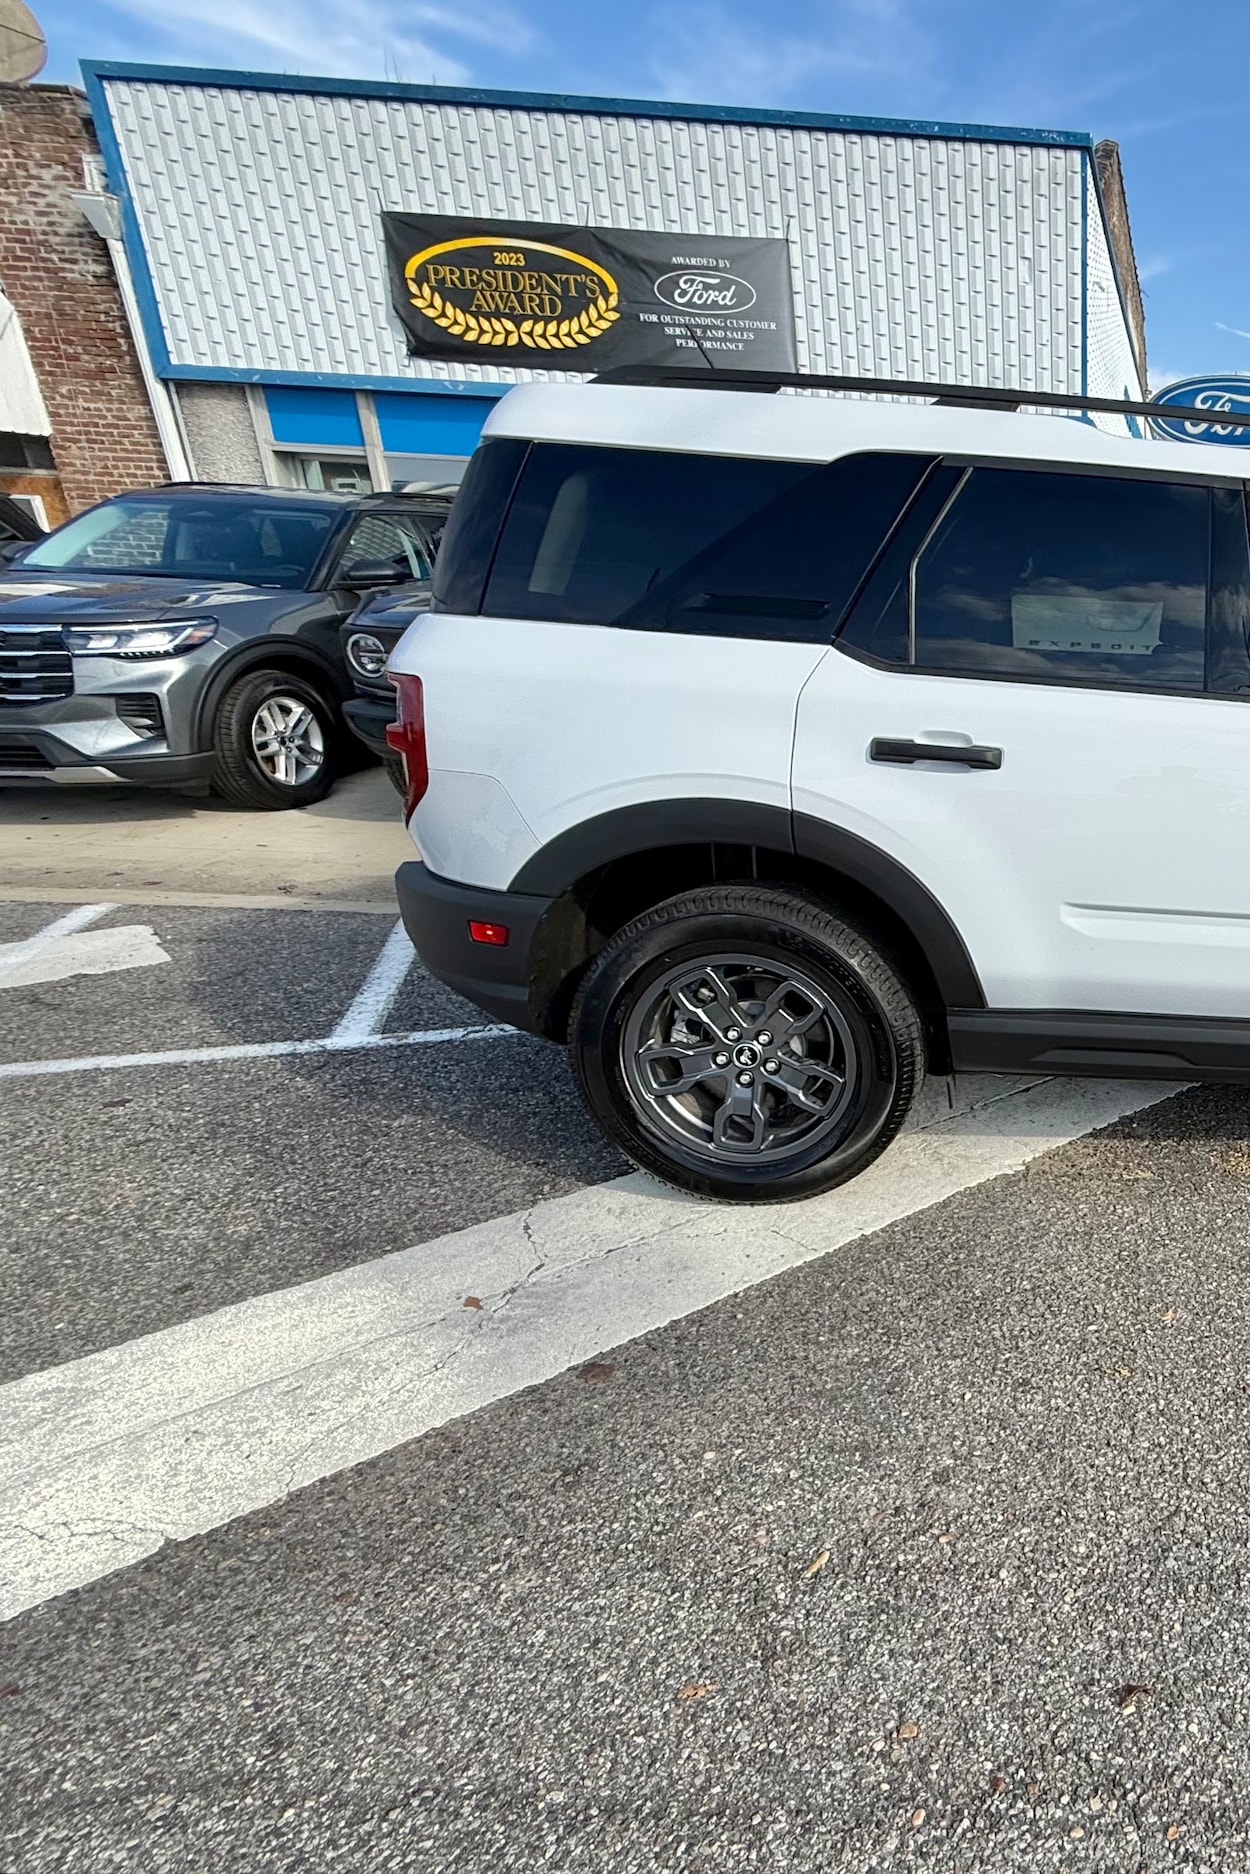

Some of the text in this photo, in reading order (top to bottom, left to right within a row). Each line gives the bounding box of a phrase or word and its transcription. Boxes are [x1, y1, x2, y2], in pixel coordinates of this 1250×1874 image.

[493, 251, 526, 266] 2023
[671, 256, 731, 268] AWARDED BY
[426, 264, 601, 298] PRESIDENT'S
[673, 275, 737, 306] Ford
[469, 290, 563, 317] AWARD
[639, 313, 777, 330] FOR OUTSTANDING CUSTOMER
[664, 326, 755, 340] SERVIE AND SALES
